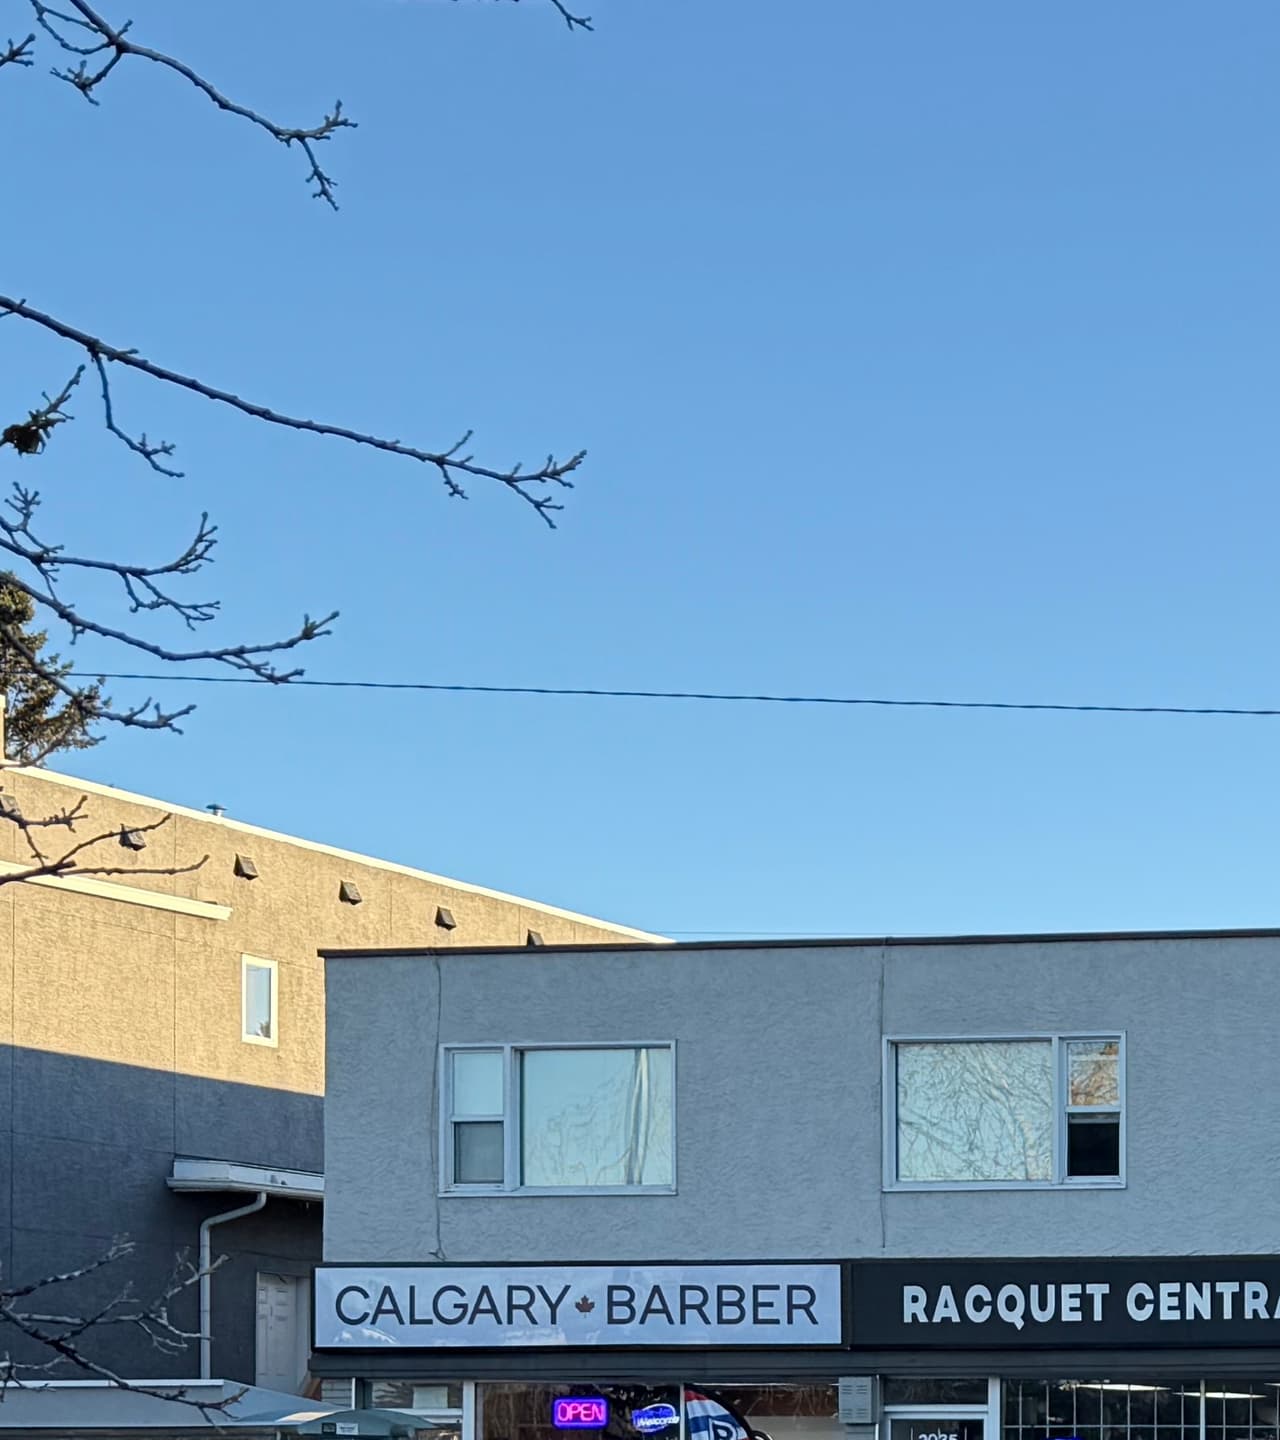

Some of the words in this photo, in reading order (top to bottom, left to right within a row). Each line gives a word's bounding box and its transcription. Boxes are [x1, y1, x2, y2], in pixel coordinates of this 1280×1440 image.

[334, 1284, 571, 1327] CALGARY
[606, 1283, 819, 1326] BARBER
[902, 1282, 1110, 1330] RACQUET
[557, 1402, 605, 1421] OPEN
